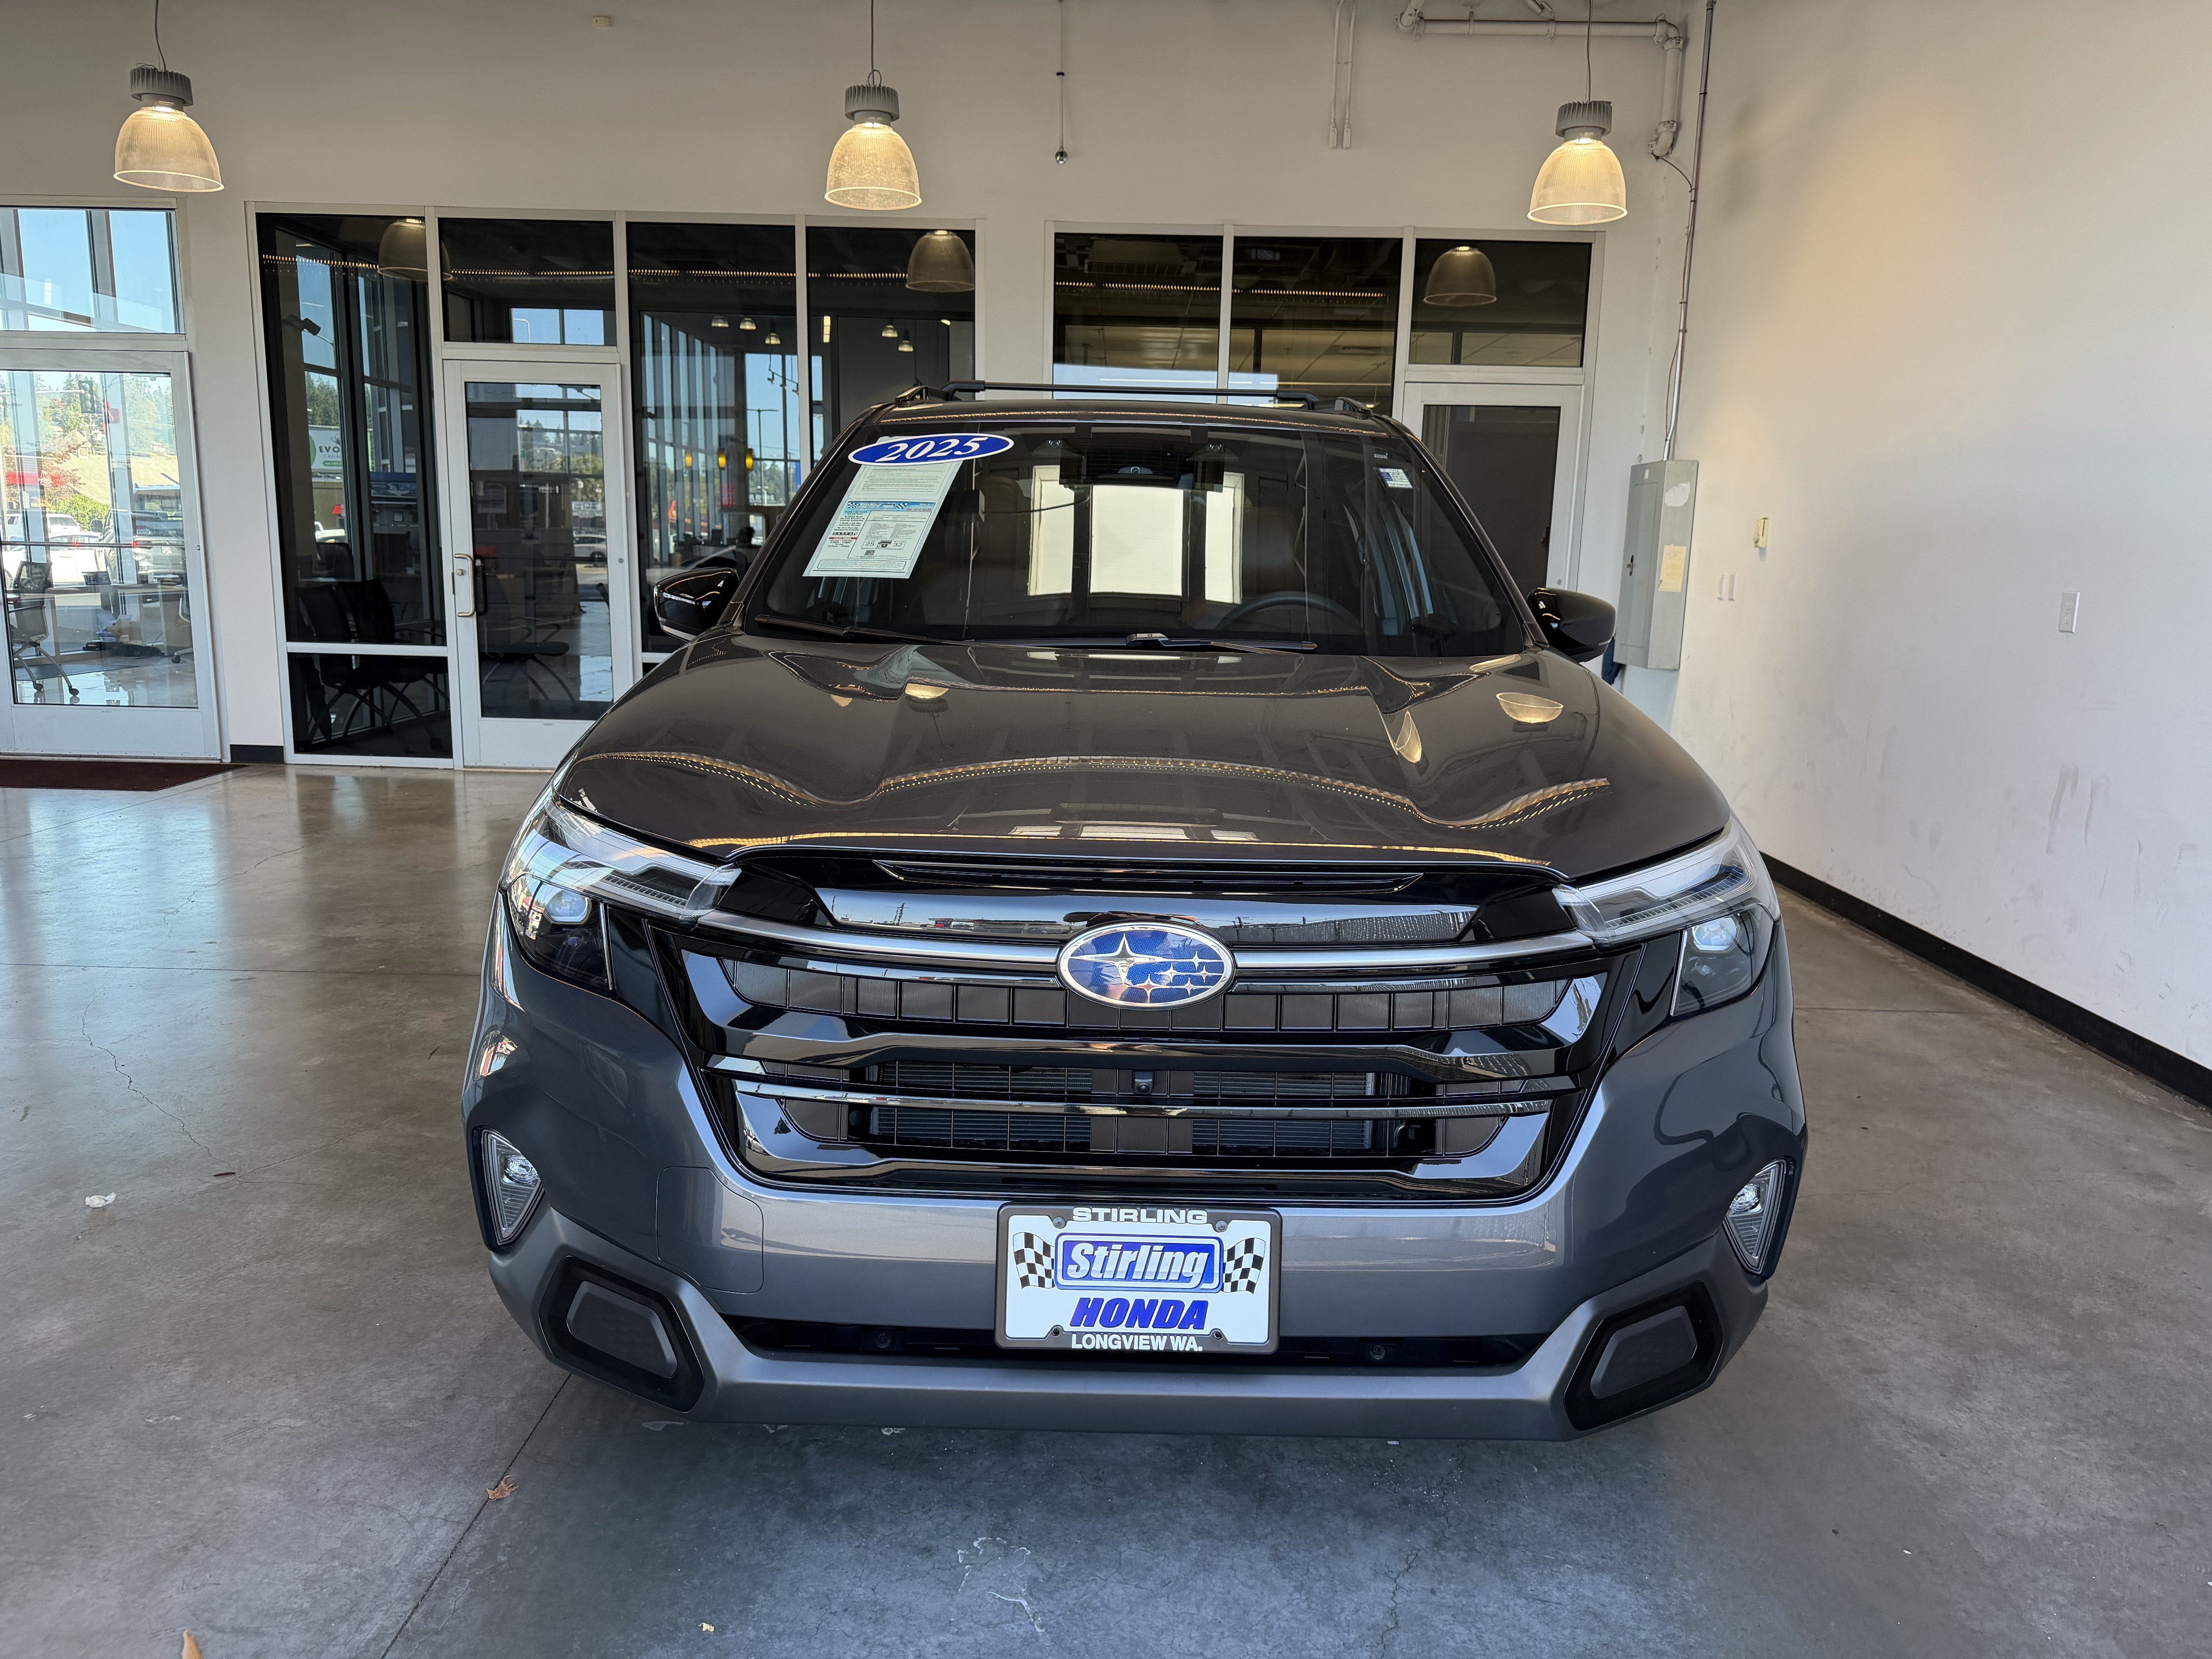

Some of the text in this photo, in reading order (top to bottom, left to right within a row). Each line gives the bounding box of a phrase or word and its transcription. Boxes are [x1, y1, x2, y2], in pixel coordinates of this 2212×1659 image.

[875, 437, 989, 462] 2025
[1072, 1207, 1208, 1224] STIRLING
[1067, 1242, 1209, 1285] Stirling
[1069, 1297, 1209, 1330] HONDA
[1072, 1334, 1203, 1352] LONGVIEW WA.
